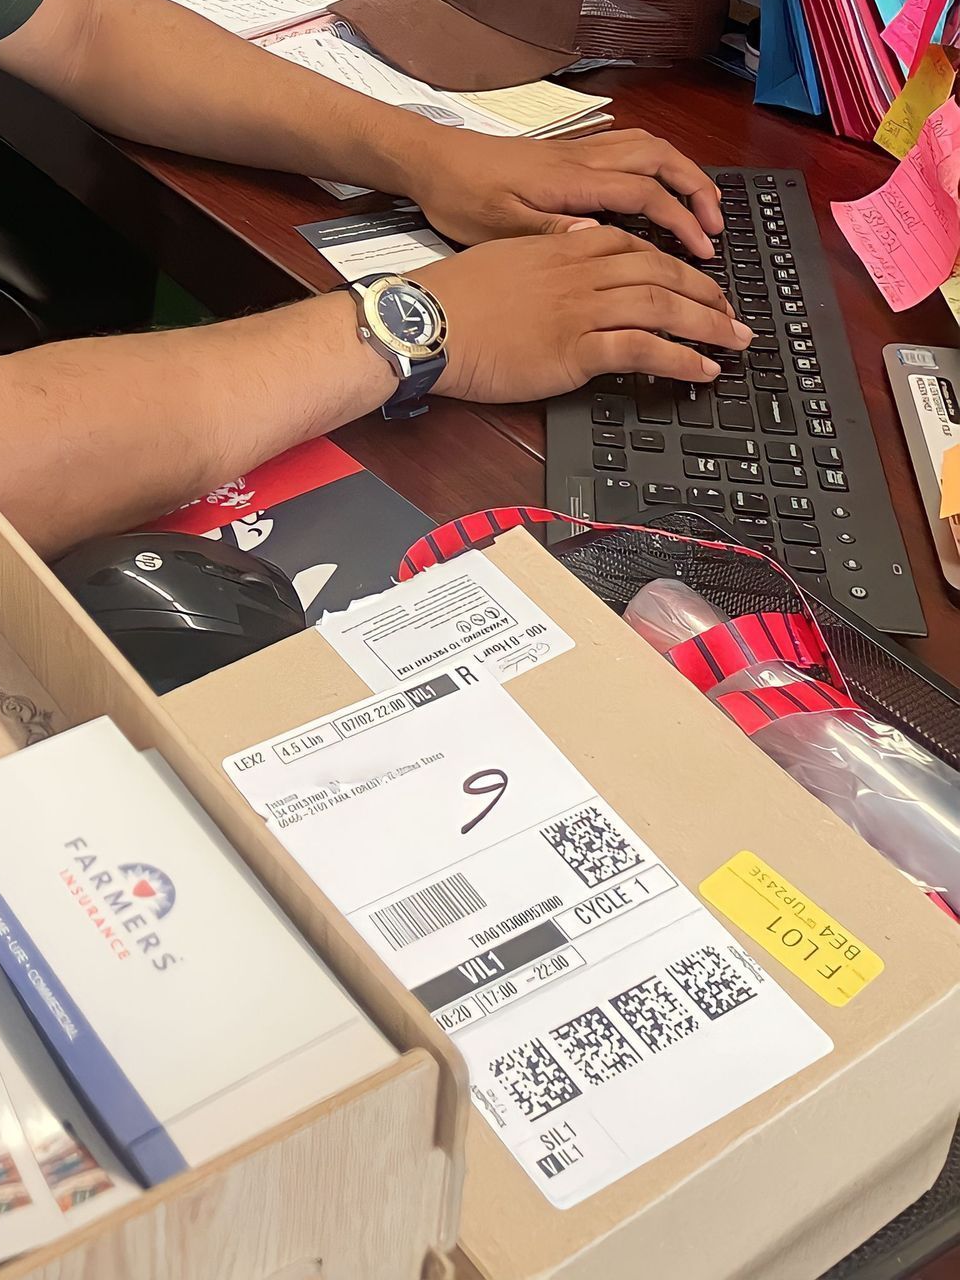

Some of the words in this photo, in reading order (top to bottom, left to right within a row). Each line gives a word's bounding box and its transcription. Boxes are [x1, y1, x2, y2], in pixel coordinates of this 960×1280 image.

[135, 551, 164, 571] hp
[455, 665, 479, 685] R
[373, 698, 407, 718] 22:00
[234, 752, 266, 772] LEX2
[59, 868, 131, 962] INSURANCE
[63, 835, 178, 973] FARMERS
[573, 885, 633, 927] CYCLE
[457, 950, 506, 986] VIL1
[481, 980, 519, 1008] 17:00
[539, 1121, 578, 1151] SIL1
